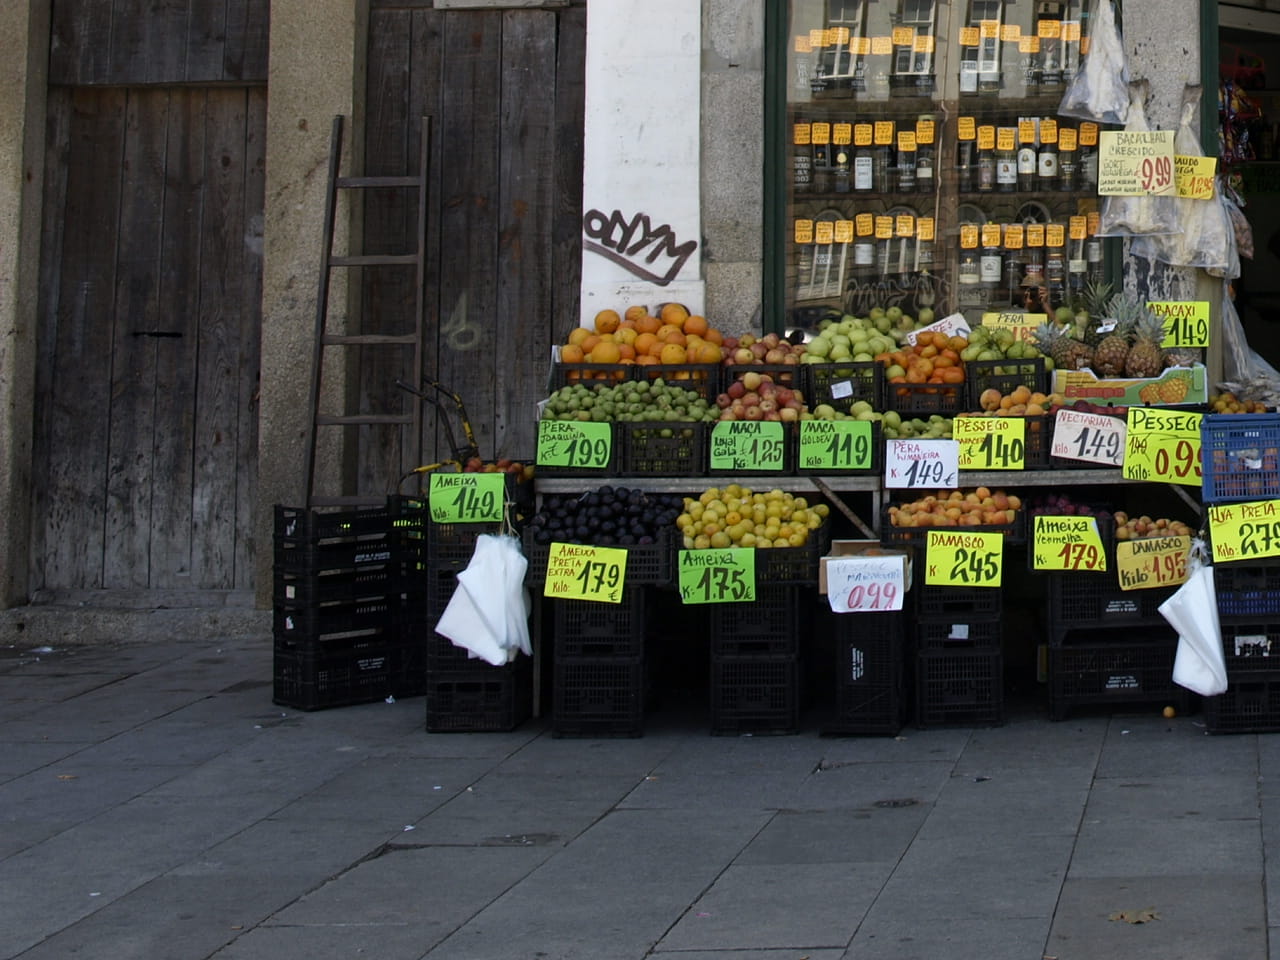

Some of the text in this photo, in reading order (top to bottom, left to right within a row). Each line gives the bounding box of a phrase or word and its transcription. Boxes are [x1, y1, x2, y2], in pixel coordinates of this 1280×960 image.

[1141, 155, 1172, 191] 9.99
[1149, 303, 1196, 317] ABACAXI
[1167, 317, 1208, 346] 1.49
[541, 420, 577, 434] PERA
[1058, 410, 1113, 428] NECTARINA
[1128, 409, 1202, 432] PÊSSEG
[978, 432, 1024, 468] 1.40
[1073, 426, 1120, 458] 1.49
[563, 438, 608, 466] 1.99
[434, 475, 478, 489] AMEIXA
[904, 459, 944, 488] 1.49
[451, 486, 495, 519] 1.49
[1241, 502, 1280, 520] PRETA
[1036, 517, 1089, 534] Ameixa
[930, 533, 985, 548] DAMASCO
[1132, 536, 1183, 556] DAMASCO
[559, 545, 596, 558] AMEIXA
[683, 550, 738, 567] Ameixa
[552, 556, 582, 568] PRETA
[949, 547, 1001, 583] 2.45
[547, 568, 576, 577] EXTRA
[575, 559, 620, 595] 1.79
[1121, 568, 1149, 587] Kilo
[696, 566, 746, 601] 1.75
